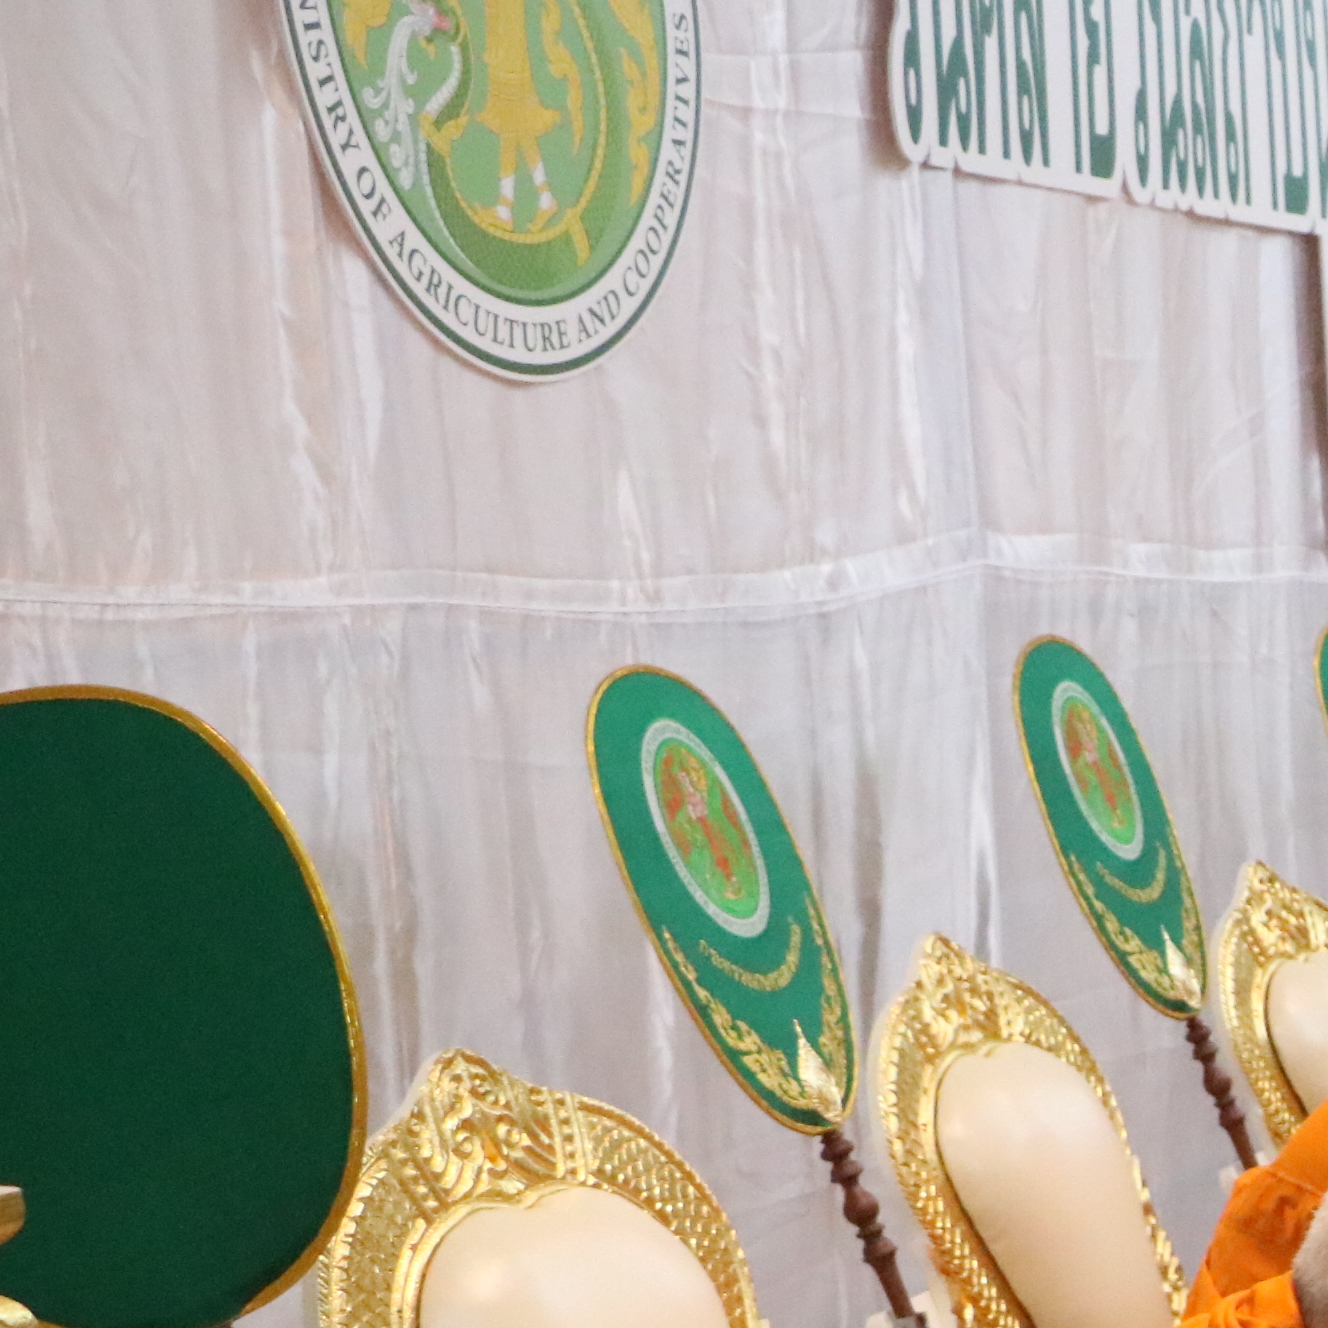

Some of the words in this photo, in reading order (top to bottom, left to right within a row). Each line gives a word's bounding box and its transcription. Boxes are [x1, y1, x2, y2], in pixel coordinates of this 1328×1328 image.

[356, 167, 394, 225] OF
[389, 231, 572, 353] AGRICULTURE
[578, 288, 624, 342] AND
[622, 12, 690, 299] COOPERATIVES
